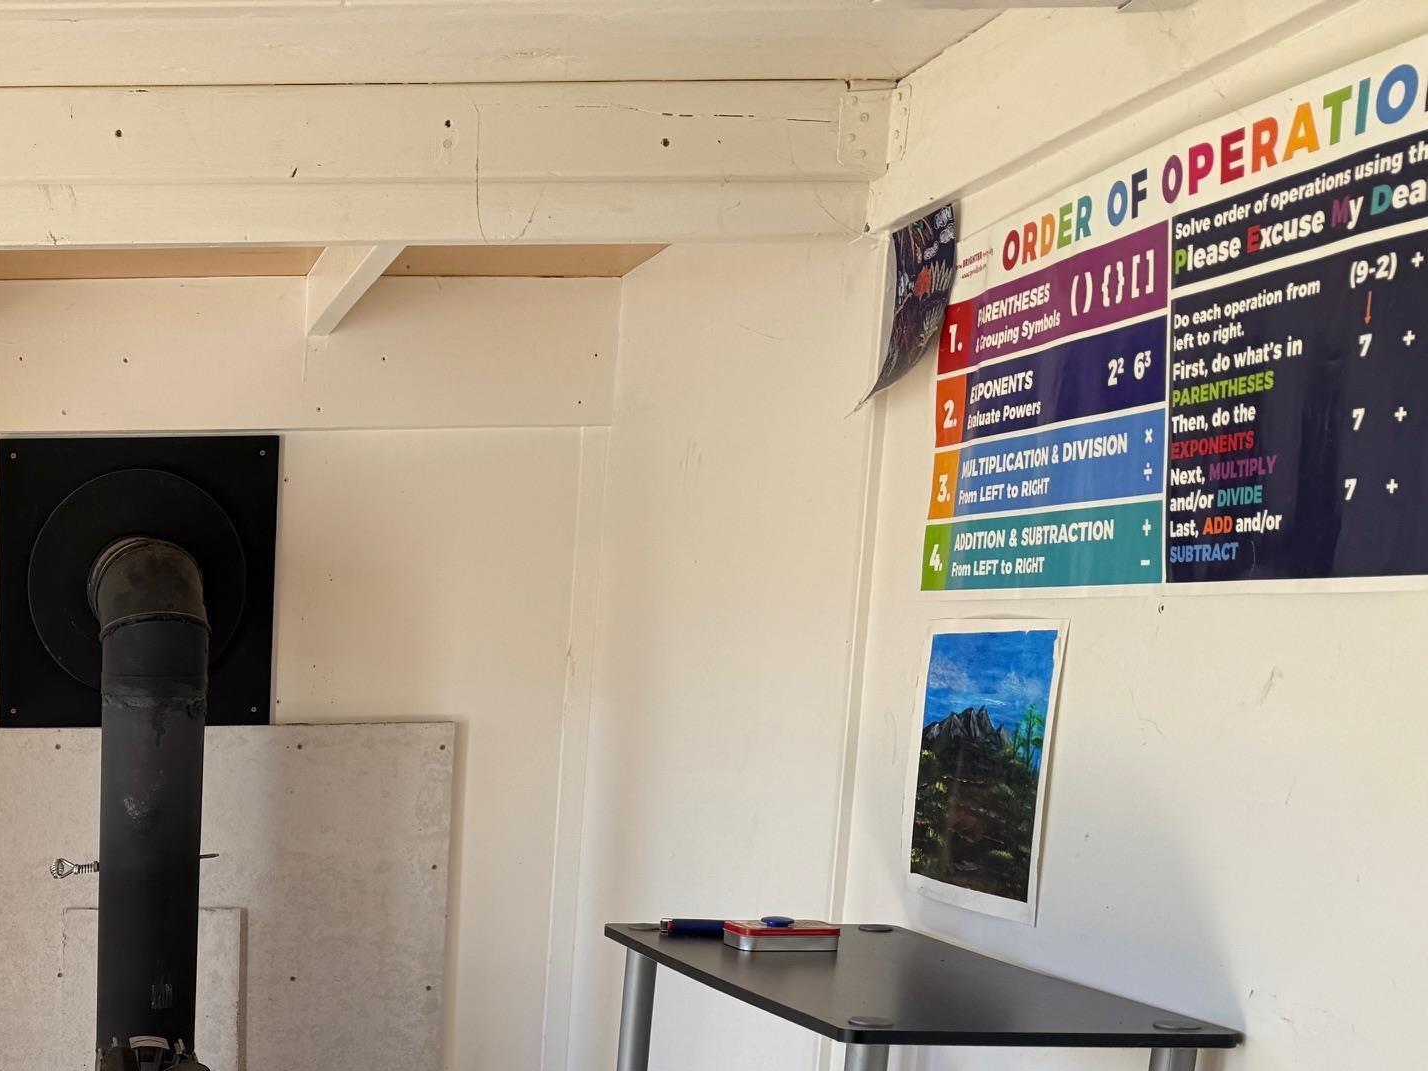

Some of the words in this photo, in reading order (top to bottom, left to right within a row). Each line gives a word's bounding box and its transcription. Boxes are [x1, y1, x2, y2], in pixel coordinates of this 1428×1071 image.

[1002, 195, 1092, 271] ORDER
[1107, 168, 1148, 227] OF
[1162, 63, 1428, 204] OPERATIO
[1175, 217, 1211, 240] Solve
[1213, 200, 1252, 225] order
[1254, 192, 1270, 214] of
[1270, 167, 1352, 211] operations
[1354, 150, 1404, 180] using
[1408, 140, 1428, 164] th
[1175, 236, 1242, 274] Please
[1247, 210, 1326, 254] Excuse
[1332, 196, 1364, 230] My
[1370, 179, 1428, 215] Dea
[1349, 252, 1398, 289] (9-2)
[977, 283, 1051, 328] PARENTHESES
[1174, 314, 1190, 329] Do
[1192, 304, 1222, 324] each
[1224, 289, 1283, 320] operation
[1286, 279, 1321, 300] from
[949, 324, 963, 353] 1.
[979, 326, 1020, 351] Grouping
[1021, 309, 1061, 340] Symbols
[1173, 333, 1195, 352] left
[1197, 331, 1211, 347] to
[1213, 322, 1245, 345] right.
[1359, 333, 1373, 357] 7
[1172, 361, 1208, 381] First,
[1212, 354, 1231, 373] do
[1234, 341, 1283, 369] what's
[1286, 335, 1303, 357] in
[970, 370, 1034, 405] EXPONENTS
[1172, 370, 1275, 408] PARENTHESES
[943, 400, 958, 429] 2.
[967, 406, 1000, 429] Evaluate
[1002, 401, 1041, 423] Powers
[1171, 415, 1209, 434] Then,
[1212, 408, 1231, 426] do
[1233, 403, 1257, 423] the
[1352, 407, 1366, 431] 7
[961, 446, 1049, 480] MULTIPLICATION
[1051, 445, 1059, 464] &
[1062, 432, 1128, 463] DIVISION
[1171, 430, 1255, 460] EXPONENTS
[1170, 466, 1206, 486] Next,
[1209, 454, 1278, 481] MULTIPLY
[937, 474, 951, 503] 3.
[958, 489, 978, 505] From
[979, 484, 1005, 502] LEFT
[1007, 483, 1019, 499] to
[1021, 478, 1050, 497] RIGHT
[1169, 489, 1215, 513] and/or
[1217, 484, 1263, 507] DIVIDE
[1344, 478, 1358, 501] 7
[954, 529, 1006, 552] ADDITION
[1009, 528, 1018, 548] &
[1021, 518, 1115, 547] SUBTRACTION
[1169, 520, 1200, 539] Last,
[1203, 516, 1234, 536] ADD
[1235, 509, 1283, 534] and/or
[929, 543, 943, 573] 4.
[951, 561, 971, 577] From
[973, 558, 998, 576] LEFT
[1001, 560, 1013, 576] to
[1015, 556, 1045, 575] RIGHT
[1170, 542, 1239, 564] SUBTRACT
